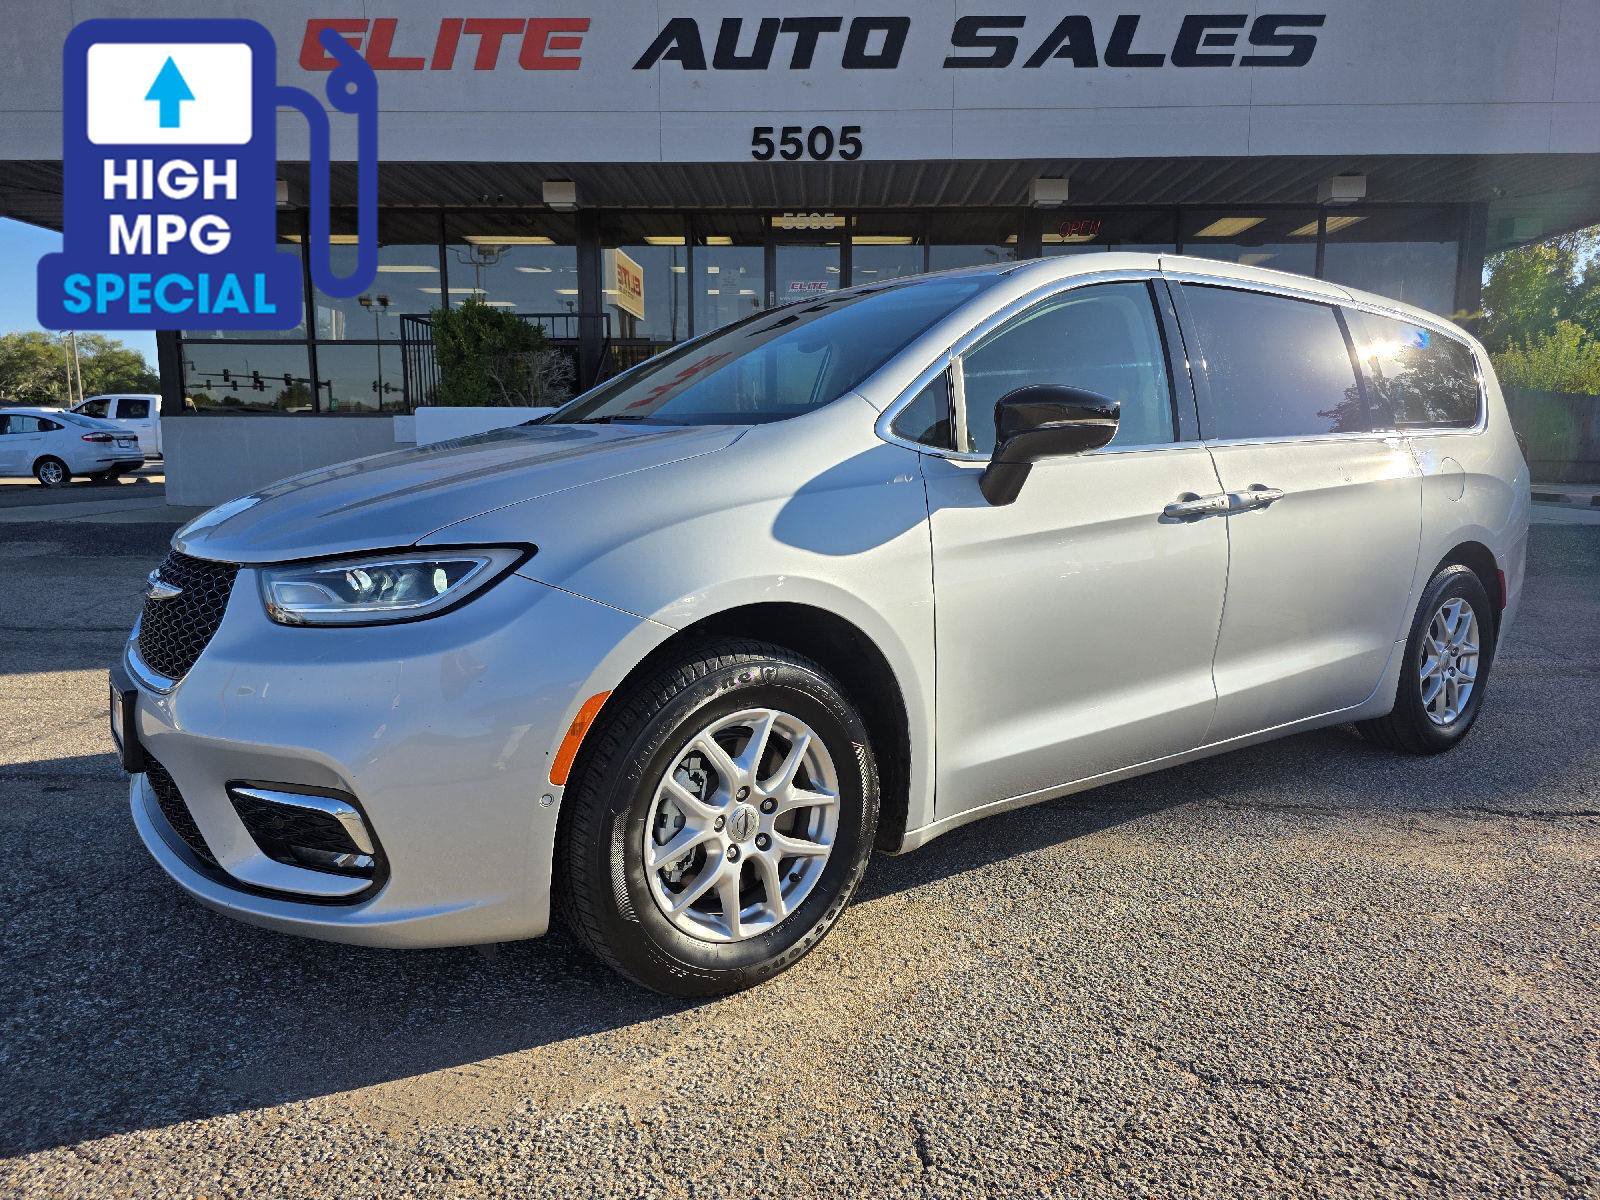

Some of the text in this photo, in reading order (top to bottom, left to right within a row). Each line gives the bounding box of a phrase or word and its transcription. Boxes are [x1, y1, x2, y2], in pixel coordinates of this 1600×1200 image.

[299, 14, 1327, 71] ELITE AUTO SALES
[751, 126, 863, 160] 5505
[782, 212, 835, 230] 5505
[1059, 219, 1101, 238] OPEN
[789, 281, 828, 290] ELITE
